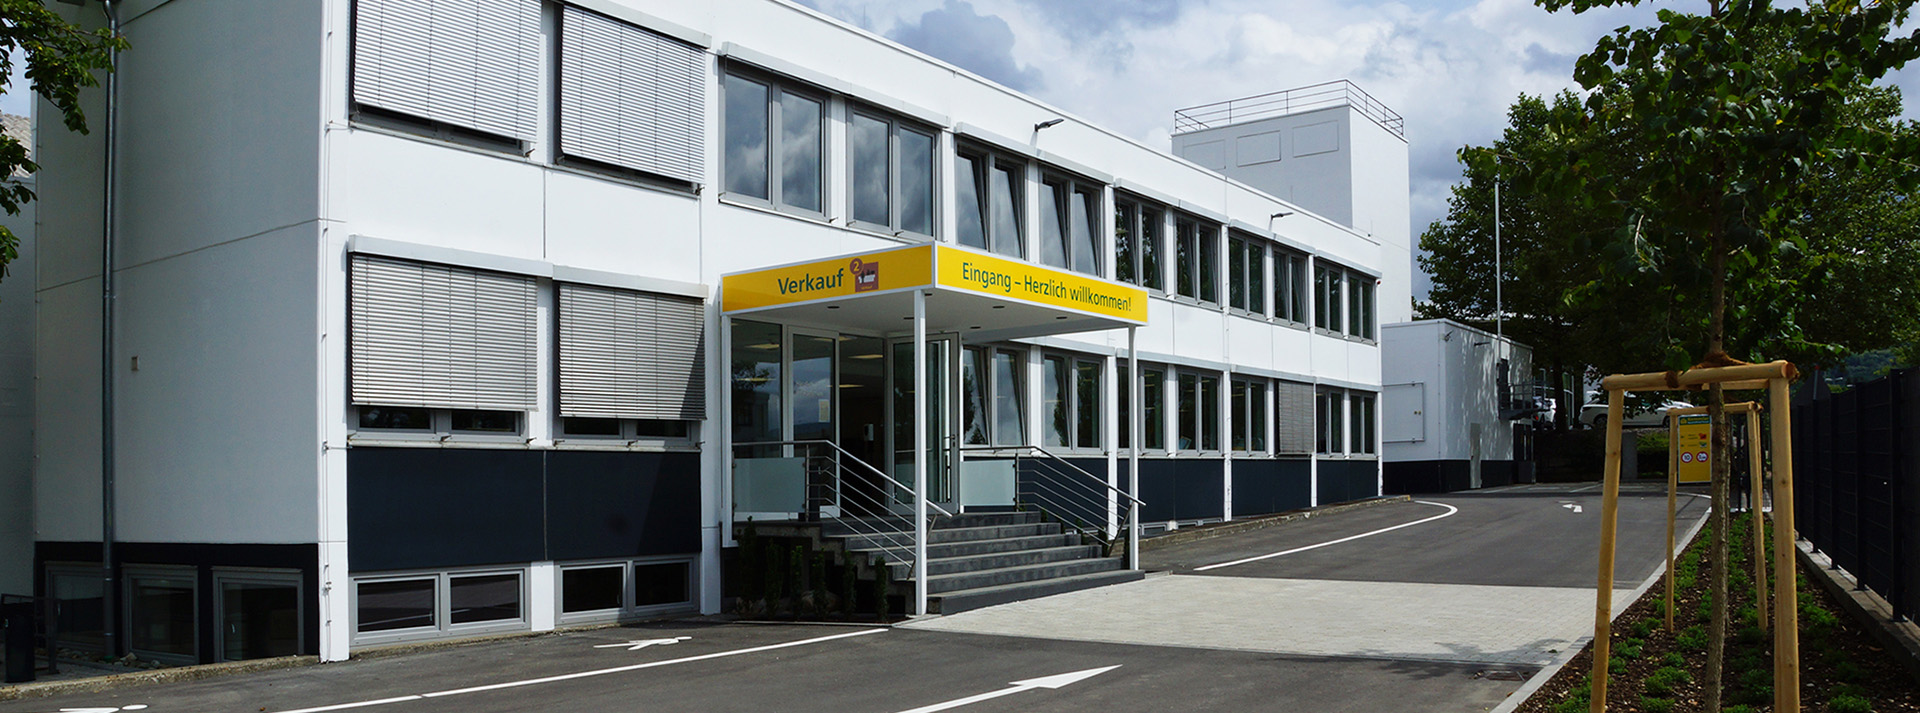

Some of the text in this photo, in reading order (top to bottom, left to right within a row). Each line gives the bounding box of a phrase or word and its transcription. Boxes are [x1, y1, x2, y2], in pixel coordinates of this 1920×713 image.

[853, 261, 860, 271] 2
[777, 268, 844, 295] Verkauf
[962, 262, 1011, 293] Eingang
[1024, 275, 1067, 299] Herzlich
[1069, 285, 1132, 312] willkommen!
